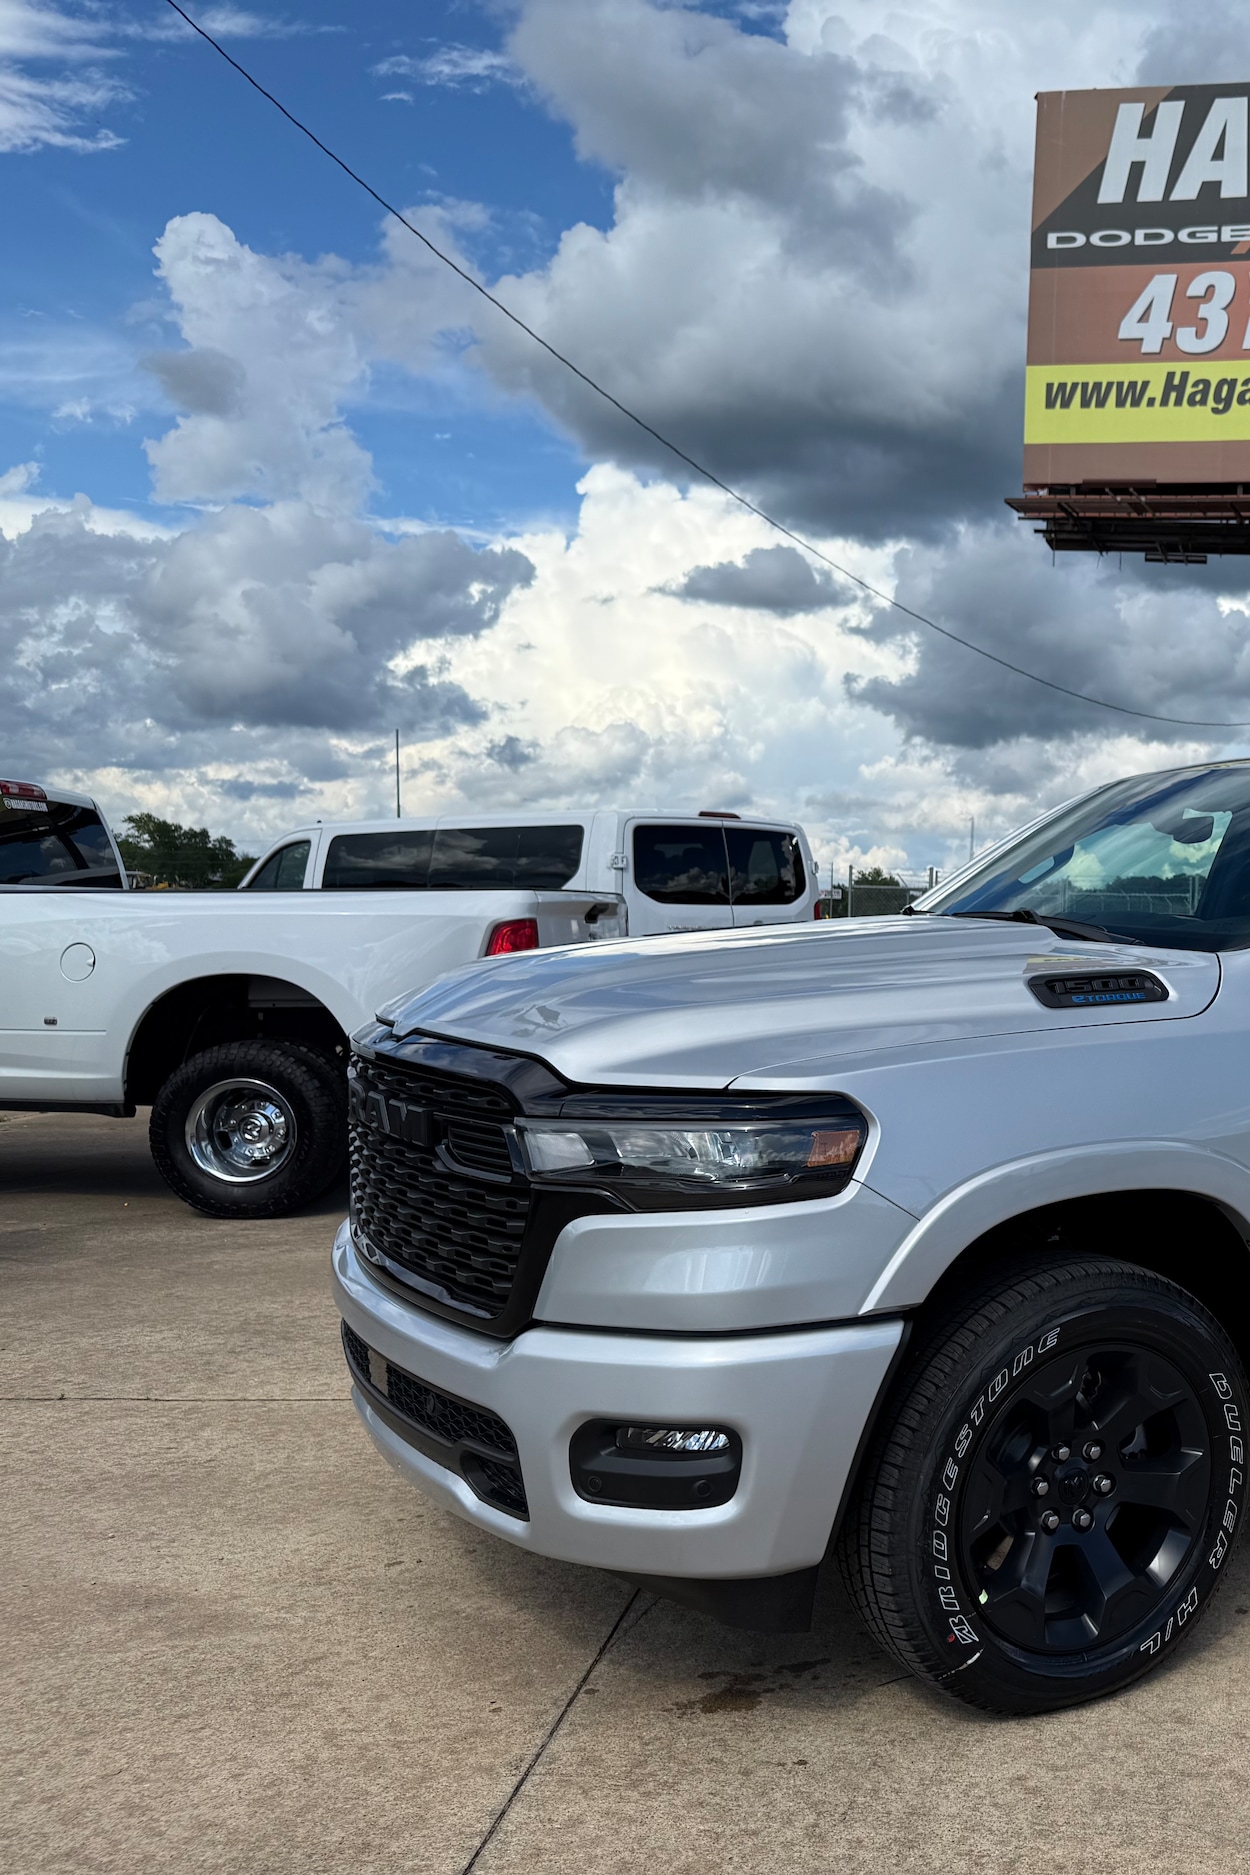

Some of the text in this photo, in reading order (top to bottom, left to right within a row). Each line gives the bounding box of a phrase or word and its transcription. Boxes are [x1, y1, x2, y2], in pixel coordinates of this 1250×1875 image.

[1118, 270, 1237, 355] 43
[1050, 978, 1145, 994] 1500
[347, 1079, 431, 1147] RAM
[933, 1327, 1060, 1645] BRIDGESTONE
[1209, 1372, 1244, 1570] DUELER
